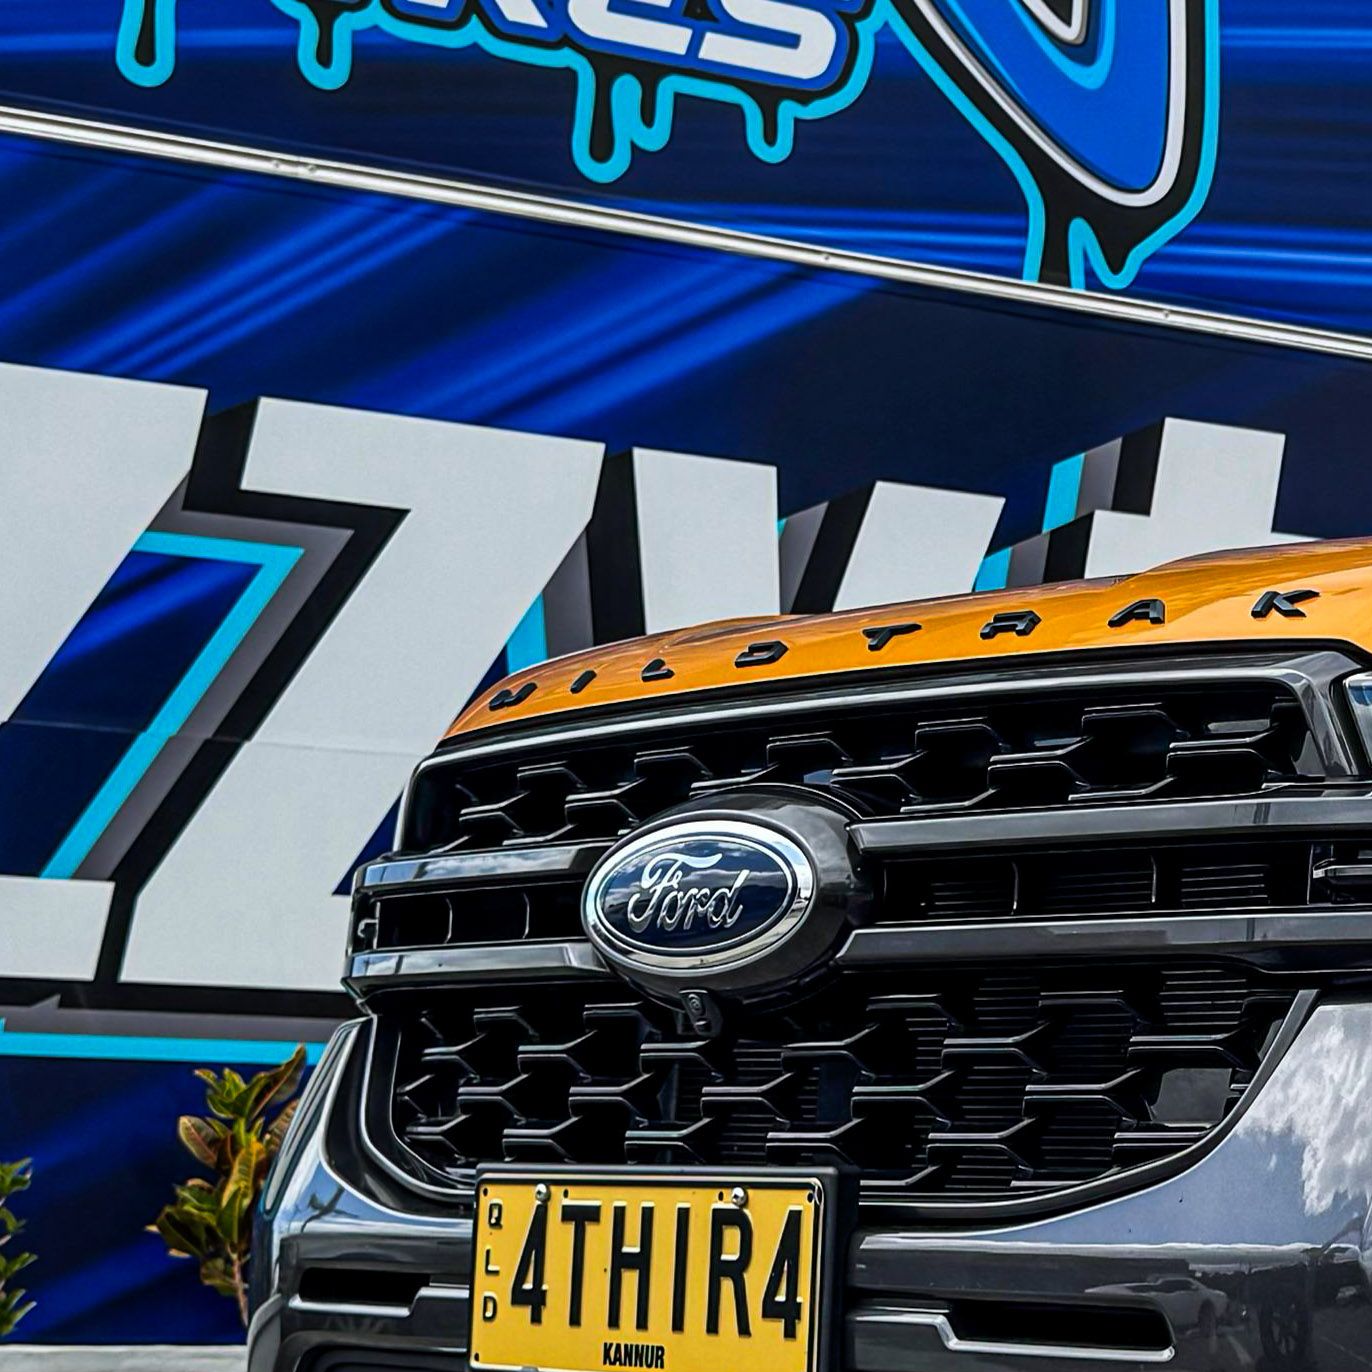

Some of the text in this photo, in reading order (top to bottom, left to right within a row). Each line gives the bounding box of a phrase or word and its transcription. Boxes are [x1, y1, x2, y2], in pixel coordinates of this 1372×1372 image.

[488, 588, 1320, 713] WILDTRAK
[627, 851, 750, 933] Ford
[510, 1201, 804, 1340] 4THIR4
[602, 1341, 666, 1369] KANNUR
